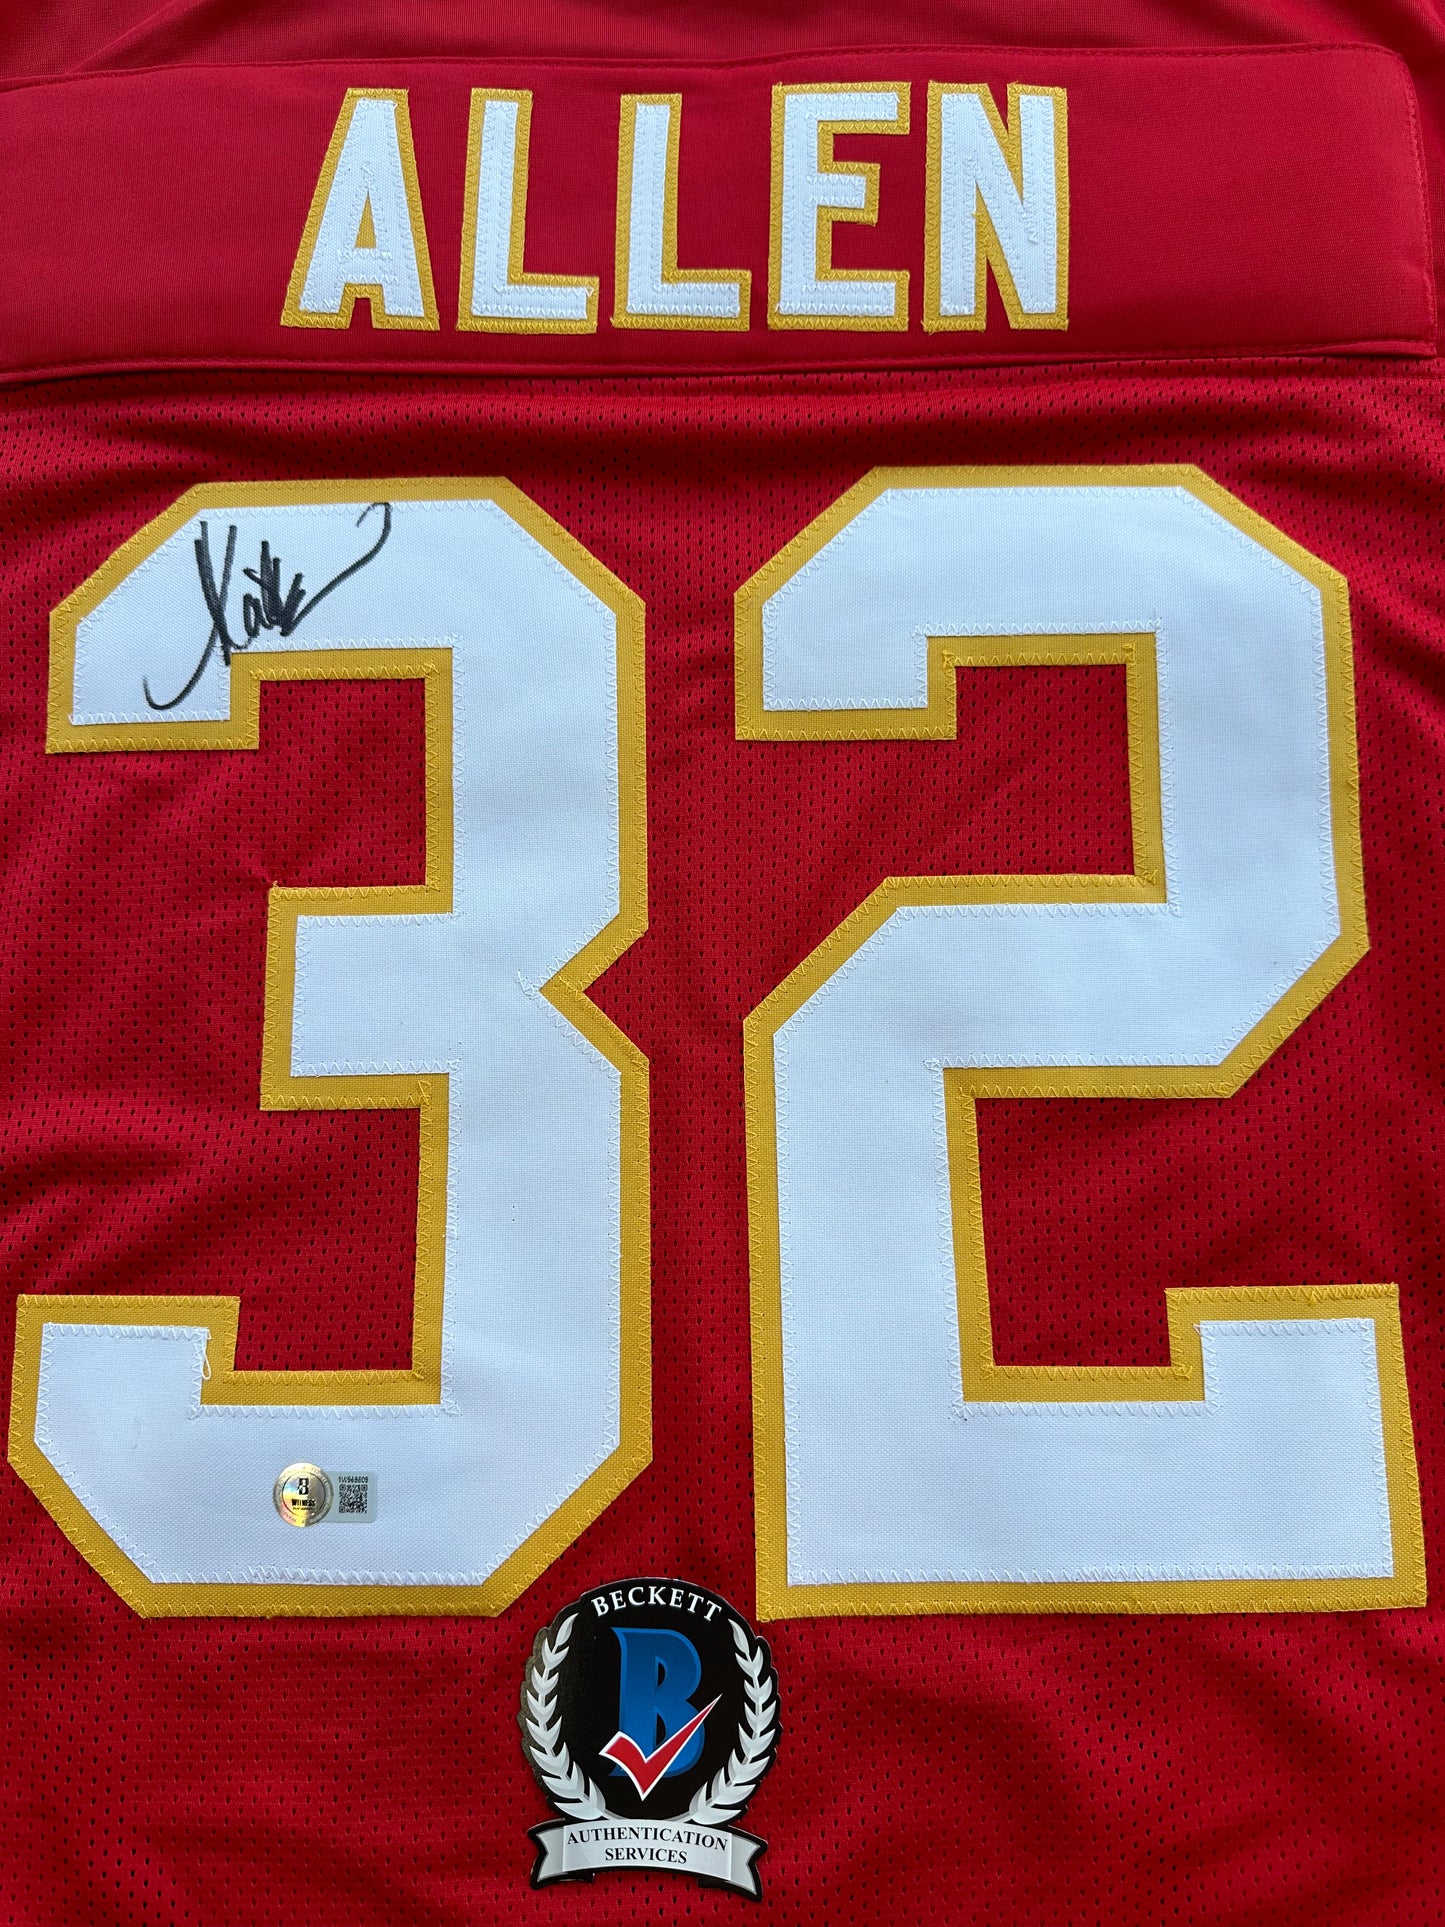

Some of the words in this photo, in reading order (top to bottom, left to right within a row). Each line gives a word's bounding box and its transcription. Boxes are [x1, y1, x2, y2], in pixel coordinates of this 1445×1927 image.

[280, 80, 1069, 334] ALLEN
[7, 462, 1429, 1623] 32
[590, 1585, 722, 1622] BECKETT
[608, 1626, 706, 1778] B
[566, 1826, 728, 1852] AUTHENTICATION
[604, 1847, 688, 1865] SERVICES
